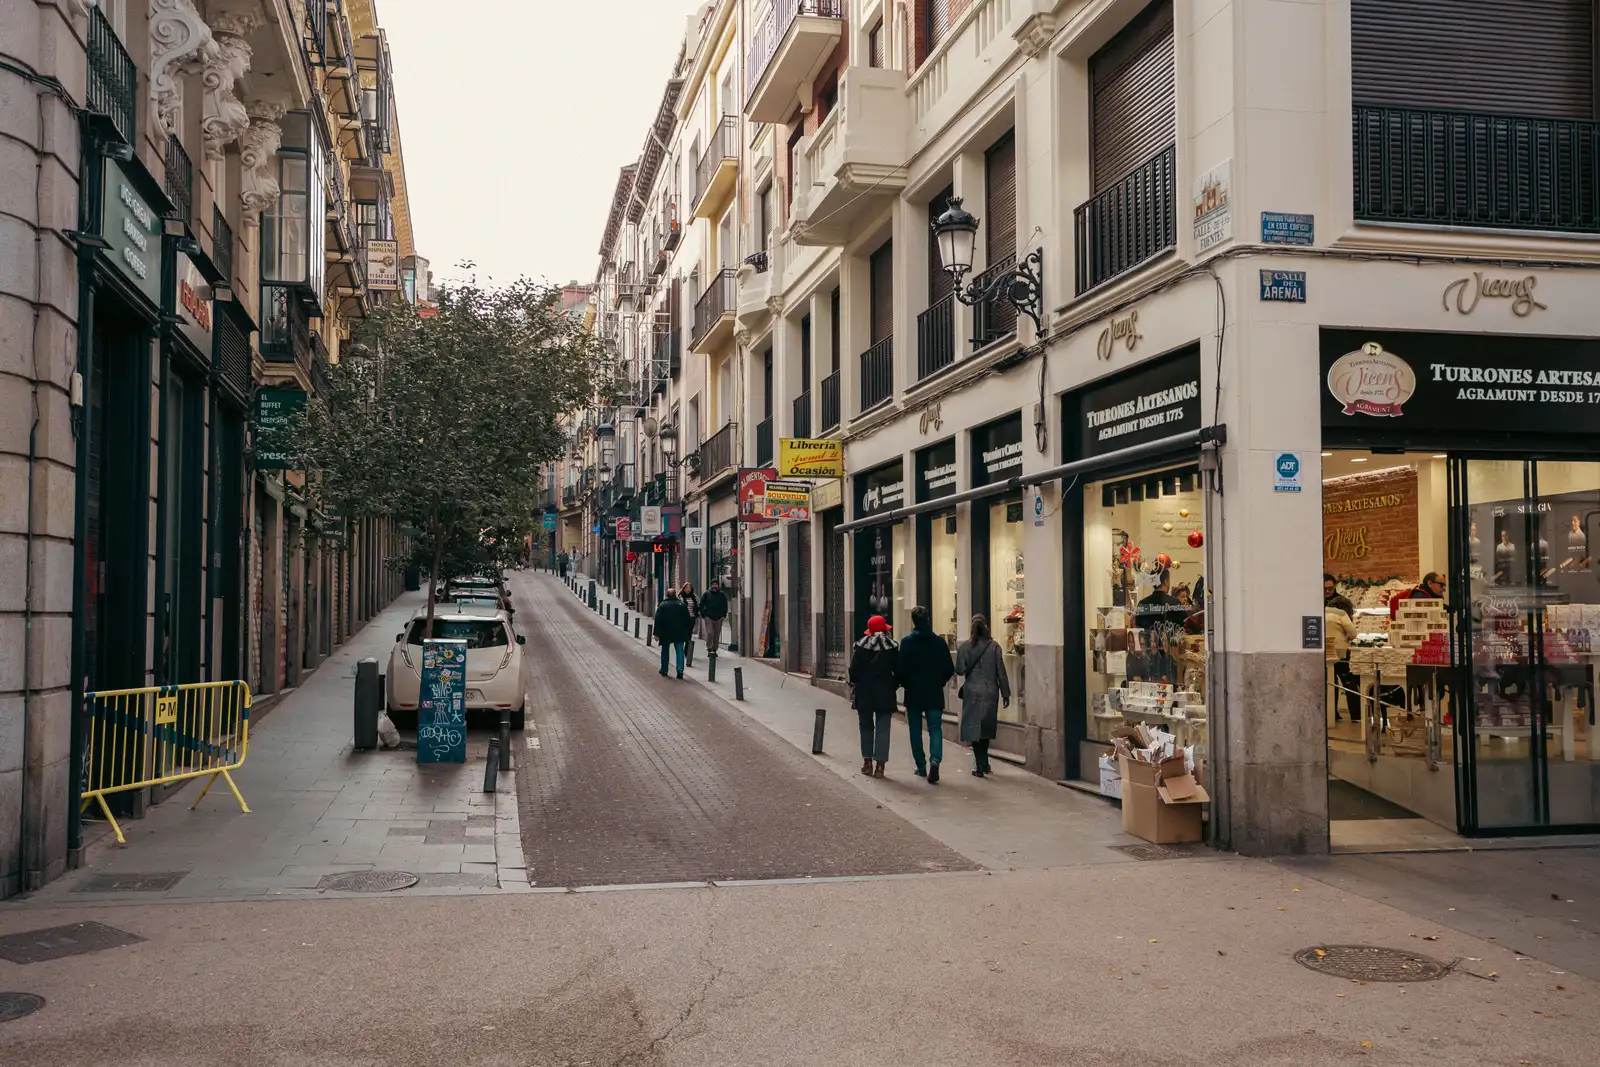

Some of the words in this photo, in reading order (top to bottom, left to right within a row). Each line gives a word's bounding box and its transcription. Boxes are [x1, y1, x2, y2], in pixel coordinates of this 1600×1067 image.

[1193, 222, 1211, 240] CALLE
[1200, 229, 1224, 250] FUENTES
[1274, 272, 1305, 281] CALLE
[1264, 286, 1304, 300] ARENAL
[1443, 272, 1548, 317] Vicens
[1336, 367, 1411, 400] Vicens
[1430, 364, 1533, 385] TURRONES
[1087, 400, 1136, 428] TURRONES
[1136, 381, 1198, 414] ARTESANOS
[1457, 388, 1537, 402] AGRAMUNT
[1540, 390, 1584, 403] DESDE
[1099, 419, 1139, 440] AGRAMUNT
[1139, 412, 1164, 430] DESDE
[790, 466, 836, 475] Ocasión
[1280, 462, 1296, 470] ADT
[767, 492, 808, 500] souvenirs
[1344, 494, 1400, 511] ARTESANOS
[1326, 526, 1370, 560] Vicens
